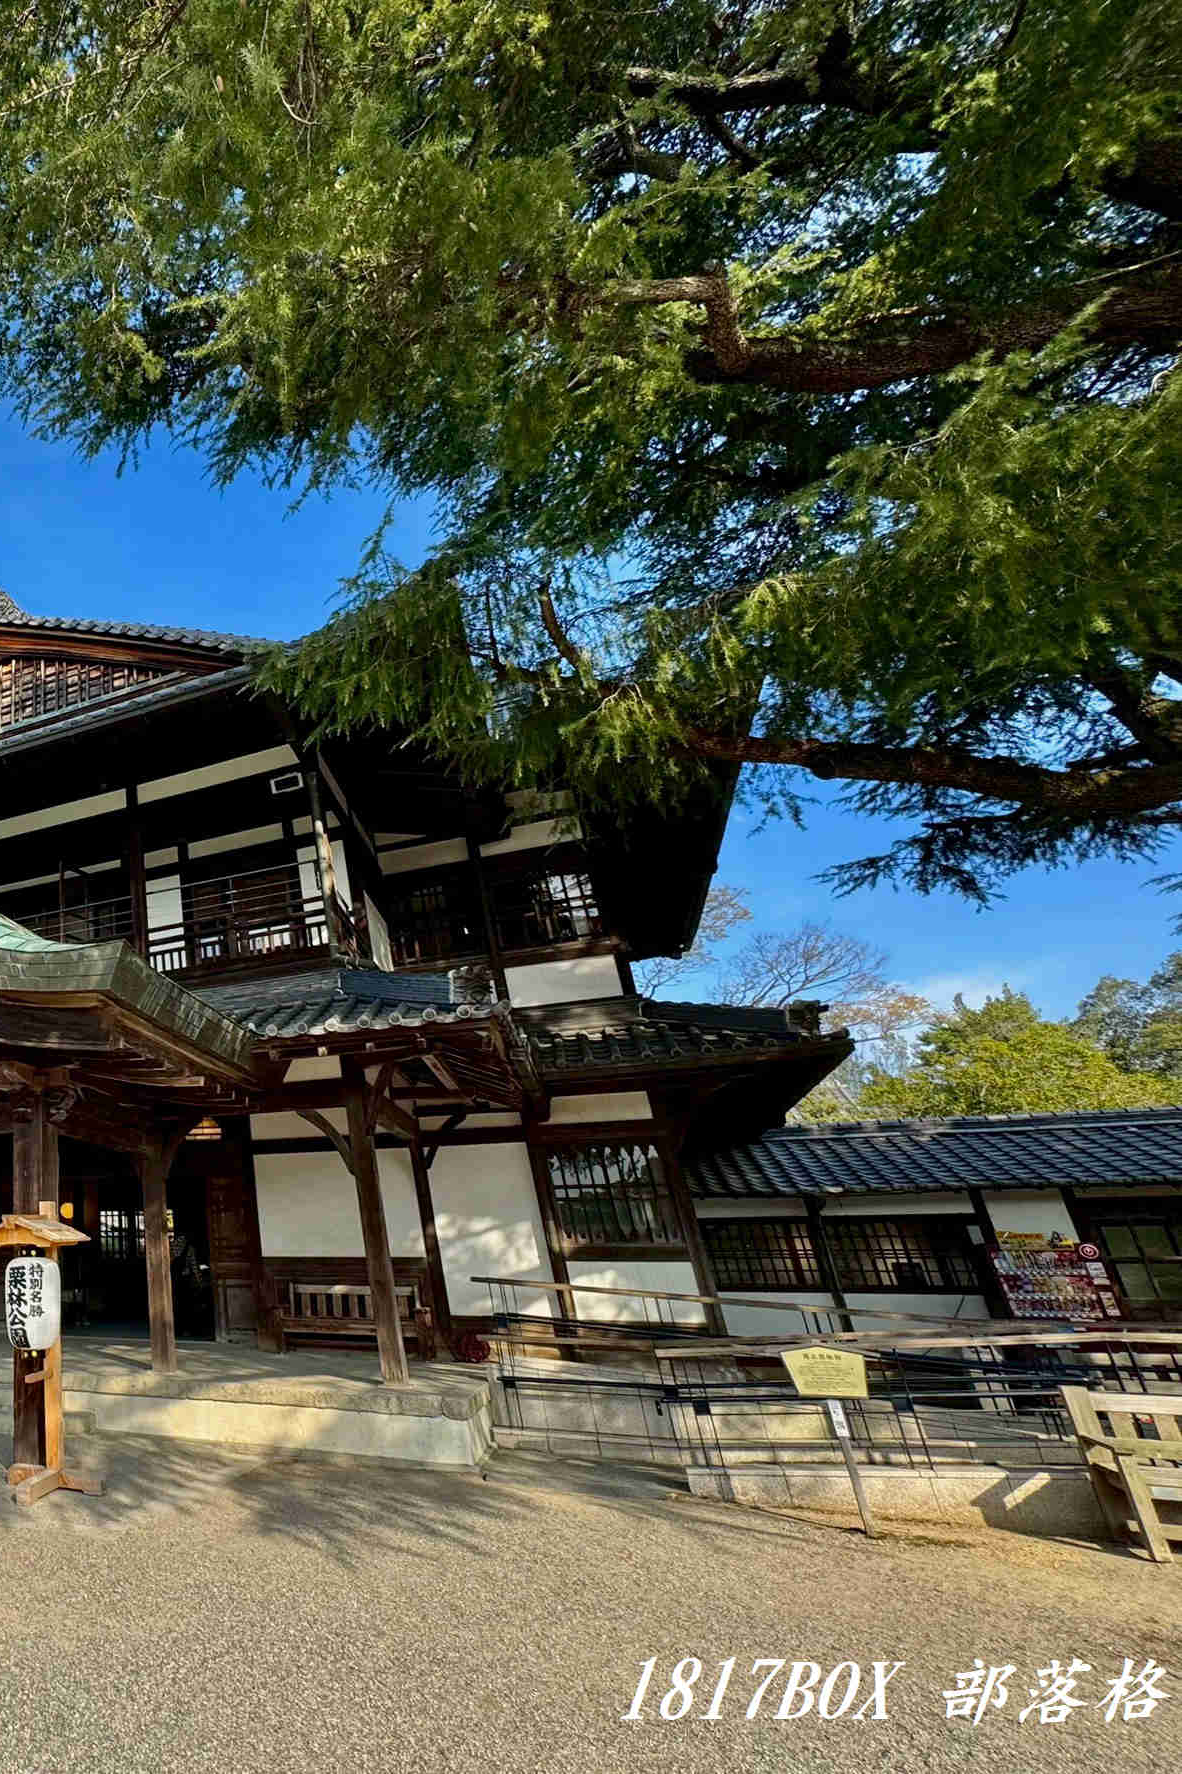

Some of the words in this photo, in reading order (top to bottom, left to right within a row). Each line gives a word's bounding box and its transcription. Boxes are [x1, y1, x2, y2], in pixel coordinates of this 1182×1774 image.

[8, 1265, 30, 1348] 栗林公園
[28, 1263, 44, 1317] 特別名勝
